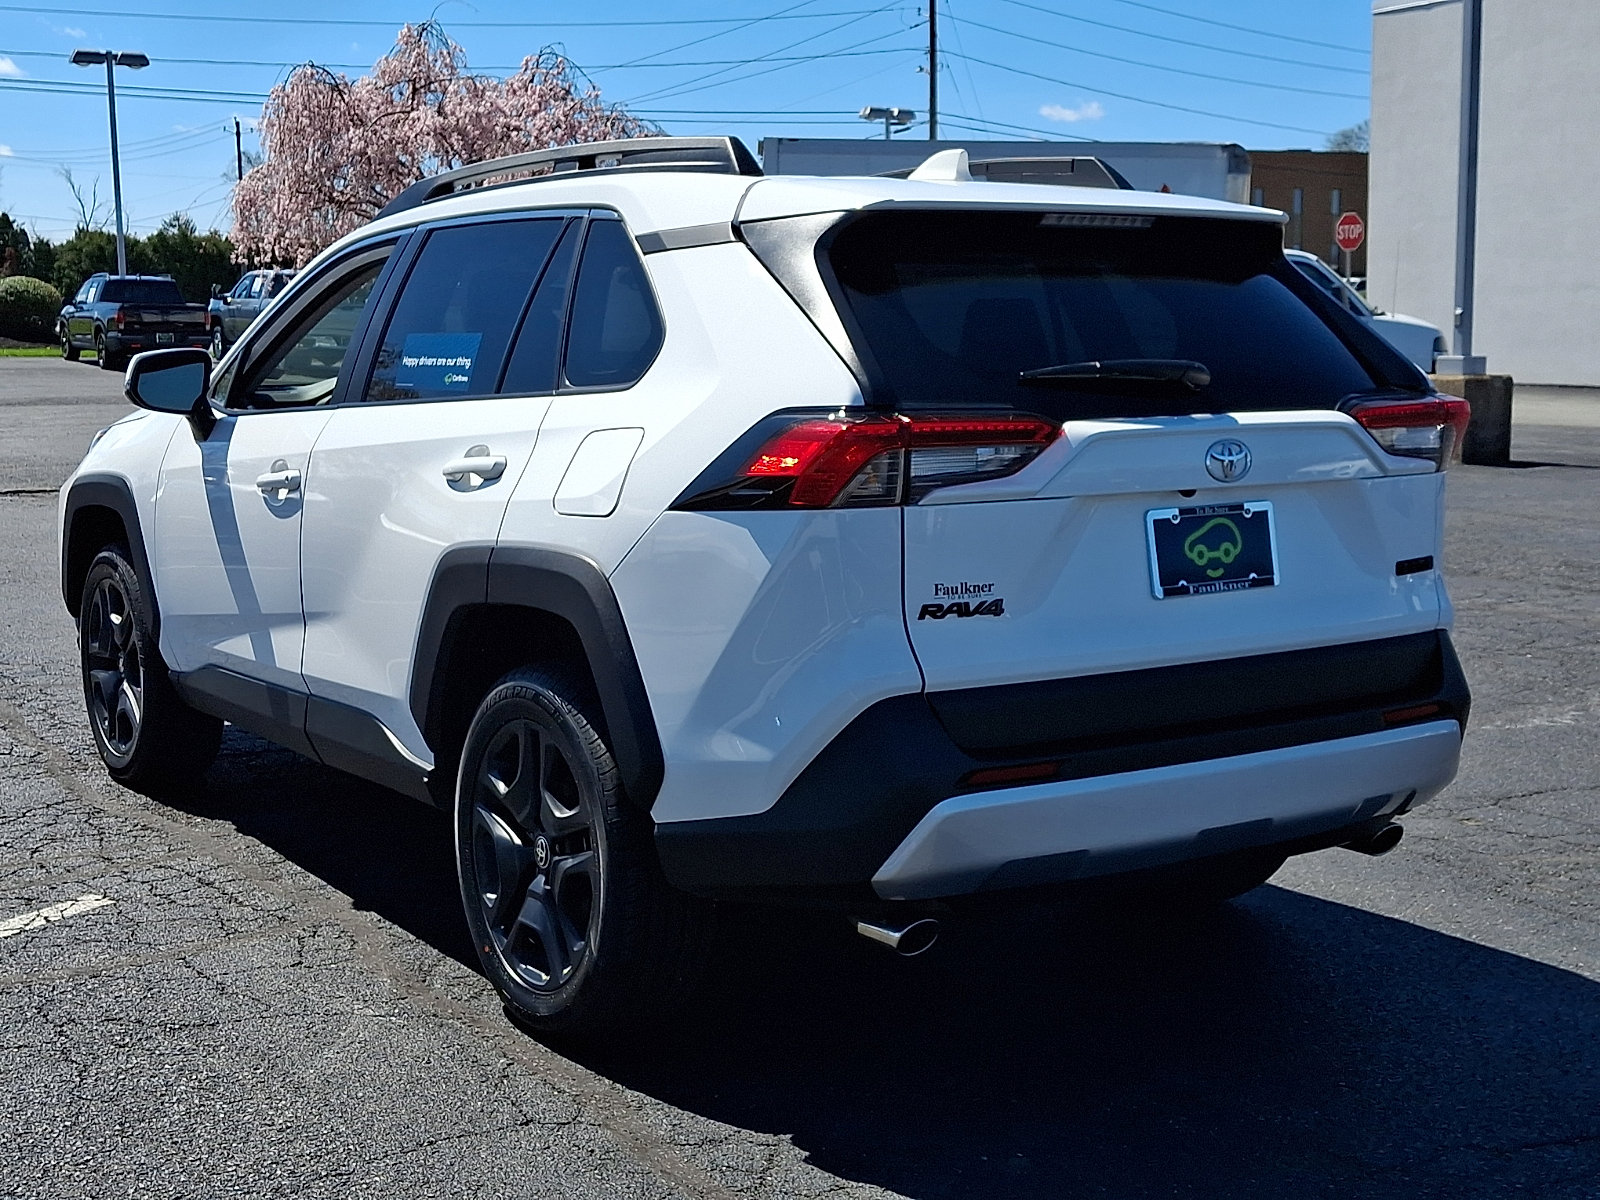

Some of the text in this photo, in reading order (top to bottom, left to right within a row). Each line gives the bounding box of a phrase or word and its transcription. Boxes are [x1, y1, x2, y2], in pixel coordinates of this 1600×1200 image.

[1338, 224, 1362, 240] STOP
[402, 355, 471, 369] Happy drivers are our thing.
[1196, 505, 1229, 515] To Be Sure
[934, 582, 994, 595] Faulkner
[1189, 580, 1251, 594] Faulkner
[917, 598, 1005, 621] RAV4
